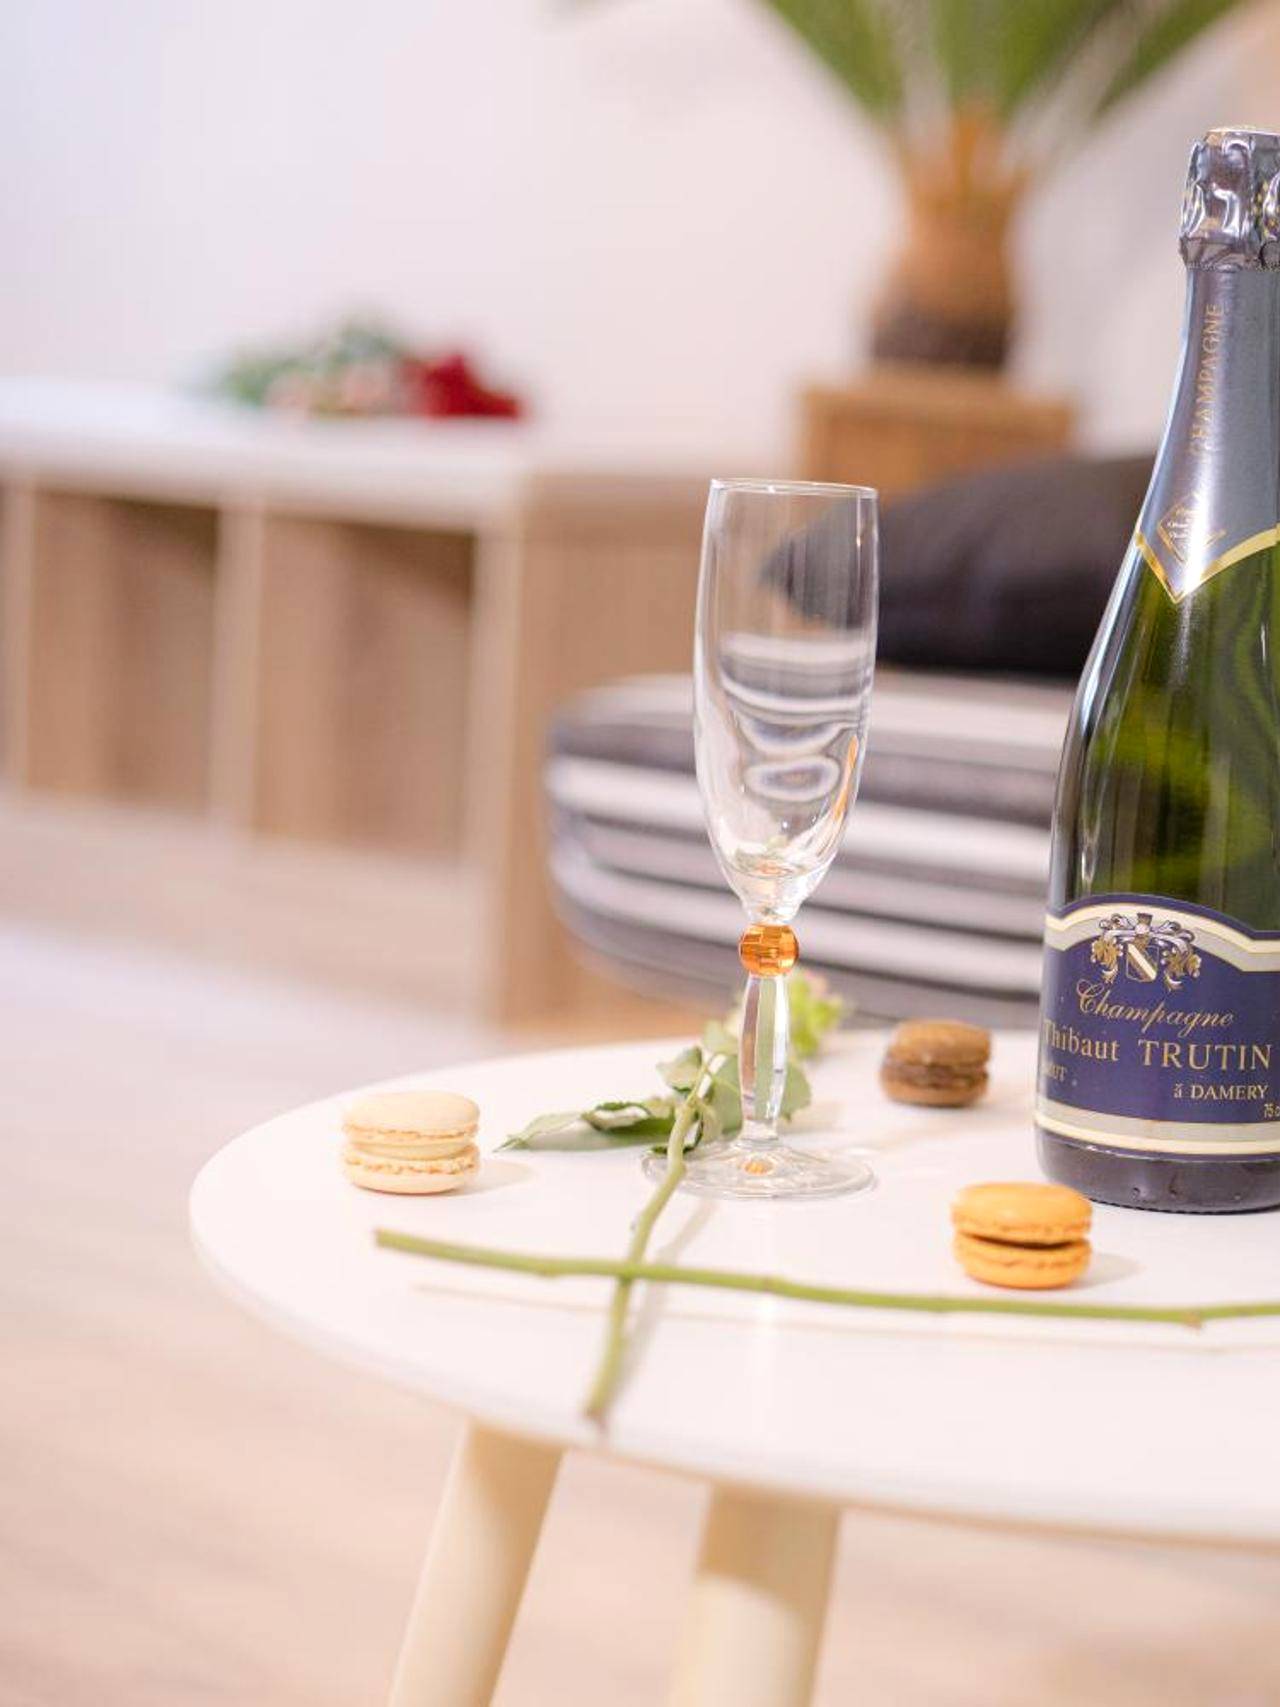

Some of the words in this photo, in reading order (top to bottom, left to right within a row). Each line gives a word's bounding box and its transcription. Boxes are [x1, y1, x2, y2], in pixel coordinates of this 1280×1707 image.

[1076, 979, 1234, 1038] Champagne
[1137, 1038, 1272, 1071] TRUTIN
[1190, 1084, 1269, 1101] DAMERY
